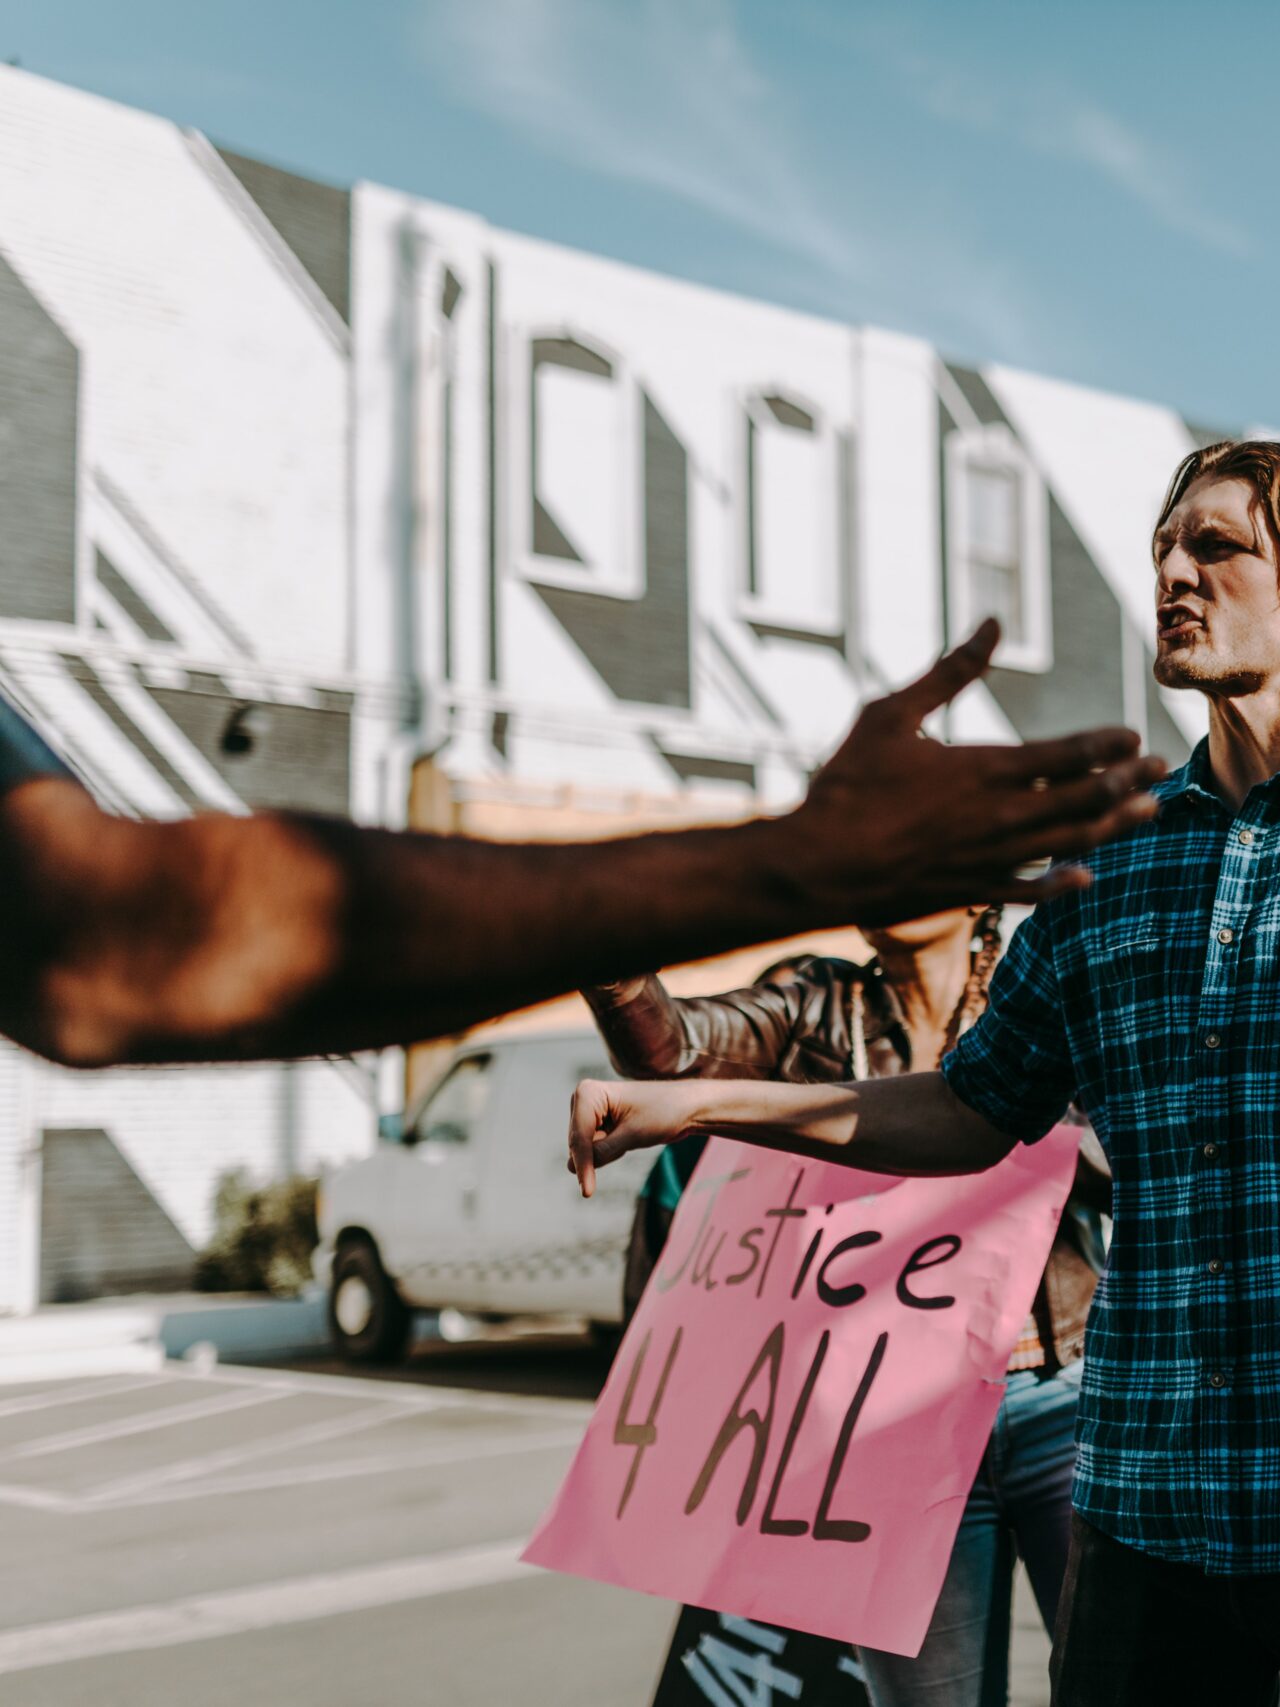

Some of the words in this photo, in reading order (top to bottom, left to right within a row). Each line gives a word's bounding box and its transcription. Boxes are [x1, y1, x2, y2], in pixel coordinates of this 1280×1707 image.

[653, 1167, 962, 1310] Justice
[612, 1326, 683, 1521] 4
[683, 1321, 889, 1543] ALL
